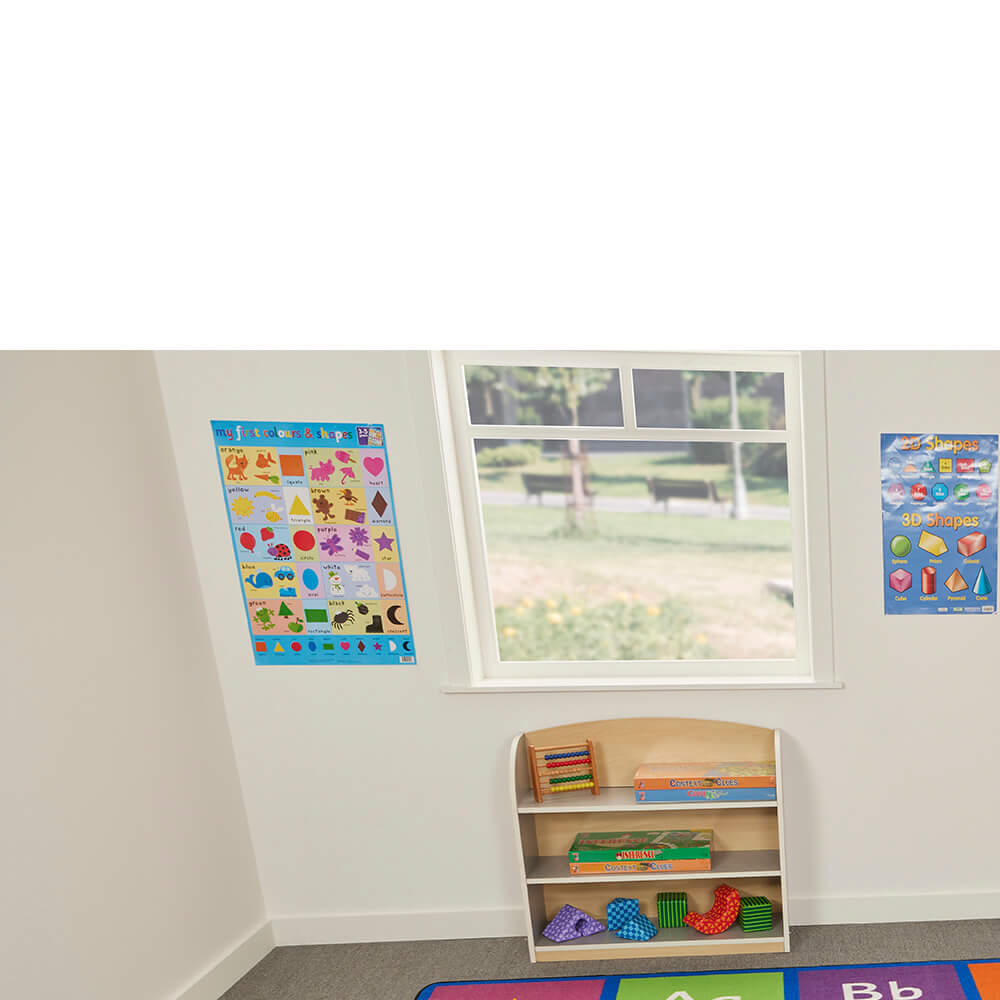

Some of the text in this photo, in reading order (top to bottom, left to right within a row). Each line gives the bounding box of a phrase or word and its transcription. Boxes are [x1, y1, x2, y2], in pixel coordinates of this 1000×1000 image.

[216, 429, 233, 440] my
[236, 426, 260, 441] first
[263, 426, 301, 438] colours
[304, 428, 312, 438] &
[317, 427, 352, 443] shapes
[901, 436, 979, 454] 2D Shapes
[902, 513, 979, 530] 3D Shapes
